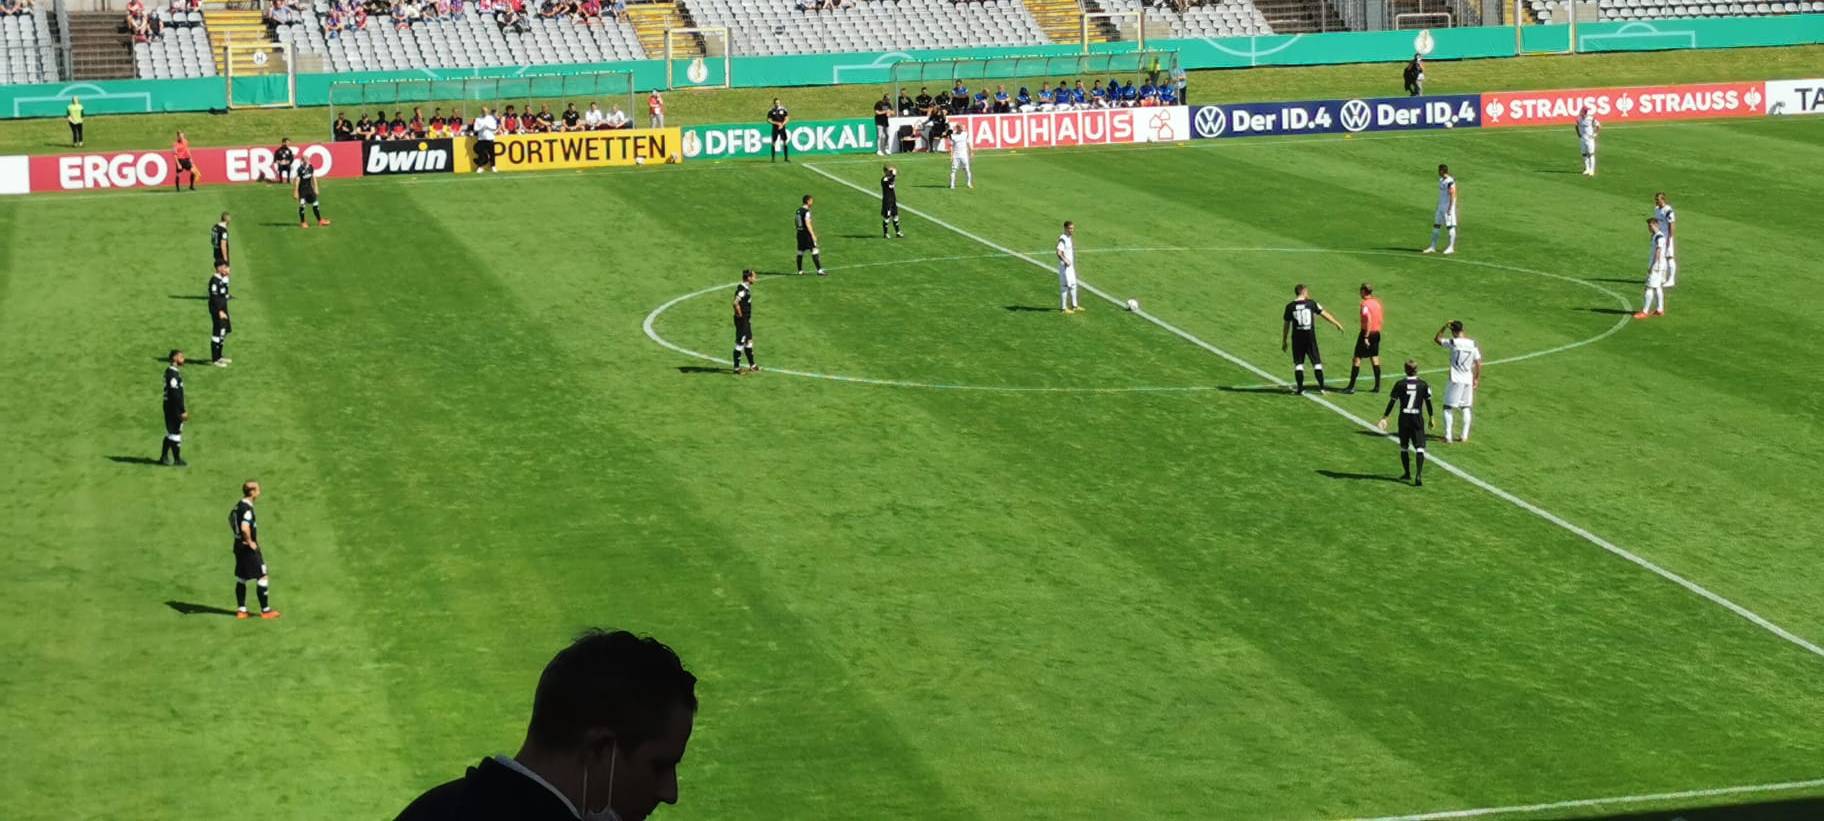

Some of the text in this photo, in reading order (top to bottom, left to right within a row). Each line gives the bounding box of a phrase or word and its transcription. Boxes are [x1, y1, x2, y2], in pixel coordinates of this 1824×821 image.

[1232, 109, 1276, 131] Der
[1282, 106, 1332, 130] ID.4
[1377, 103, 1420, 126] Der
[1426, 101, 1475, 124] ID.4
[1509, 90, 1739, 119] STRAUSS STRAUSS
[951, 112, 1132, 146] AUHAUS
[58, 152, 168, 189] ERGO
[366, 141, 447, 173] bwin
[1406, 390, 1417, 409] 7
